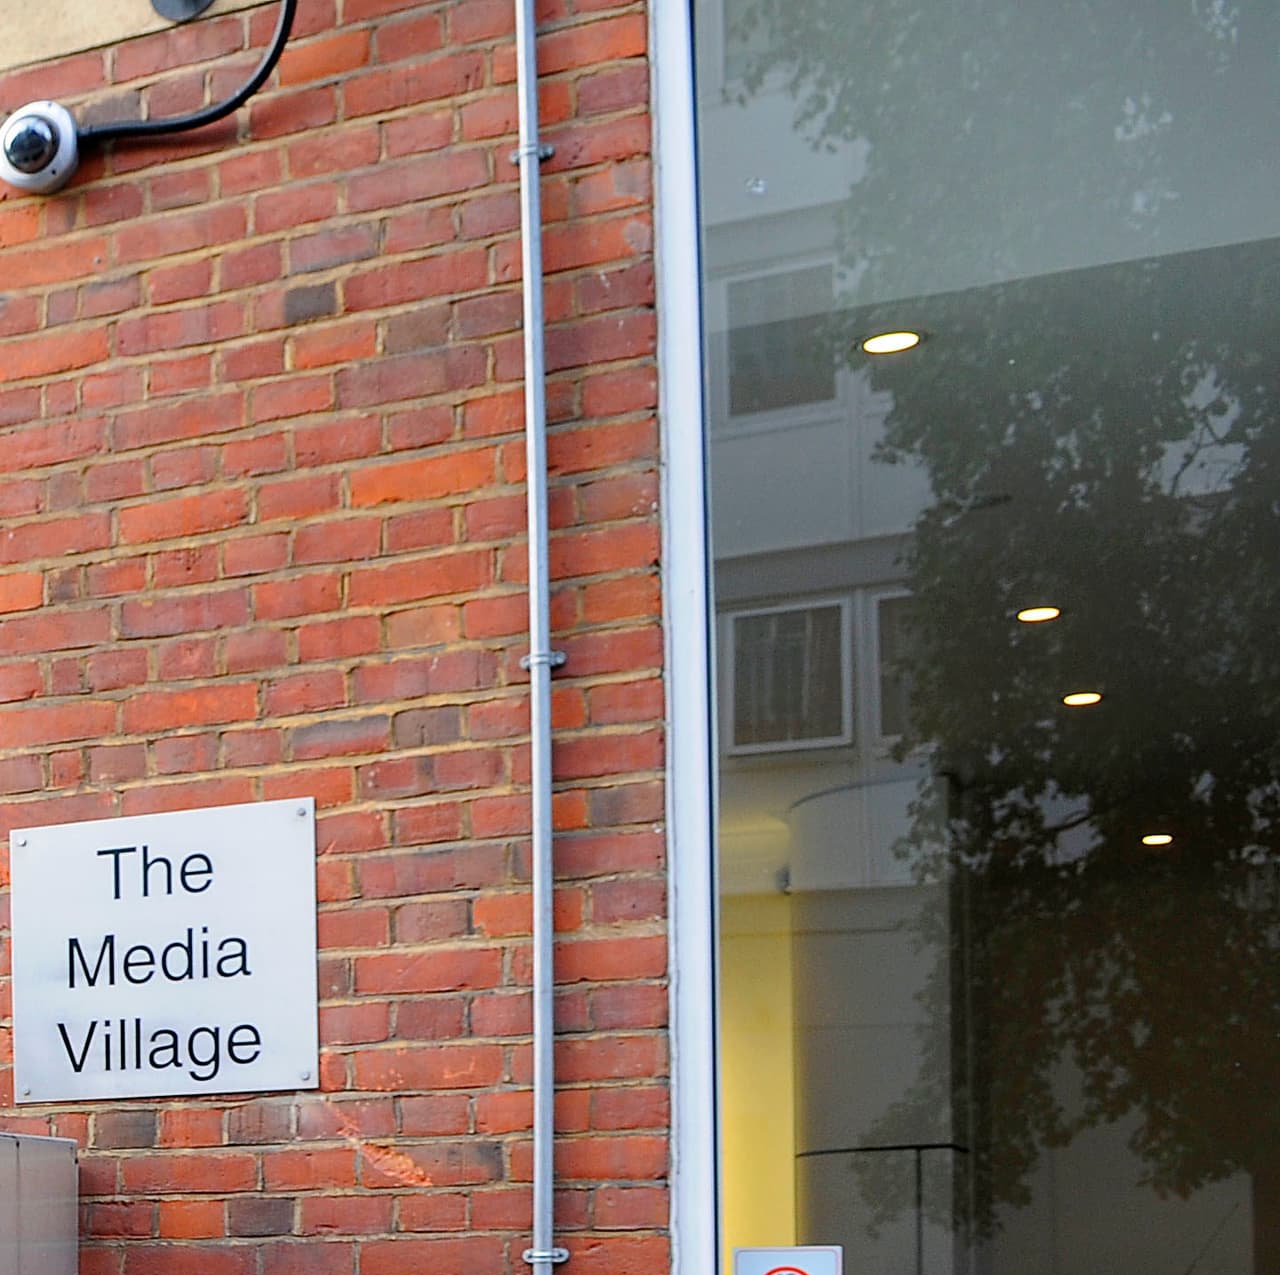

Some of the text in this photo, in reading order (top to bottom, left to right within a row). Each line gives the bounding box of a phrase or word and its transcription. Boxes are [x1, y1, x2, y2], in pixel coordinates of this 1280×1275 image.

[97, 845, 214, 900] The
[68, 926, 252, 989] Media
[57, 1017, 262, 1082] Village
